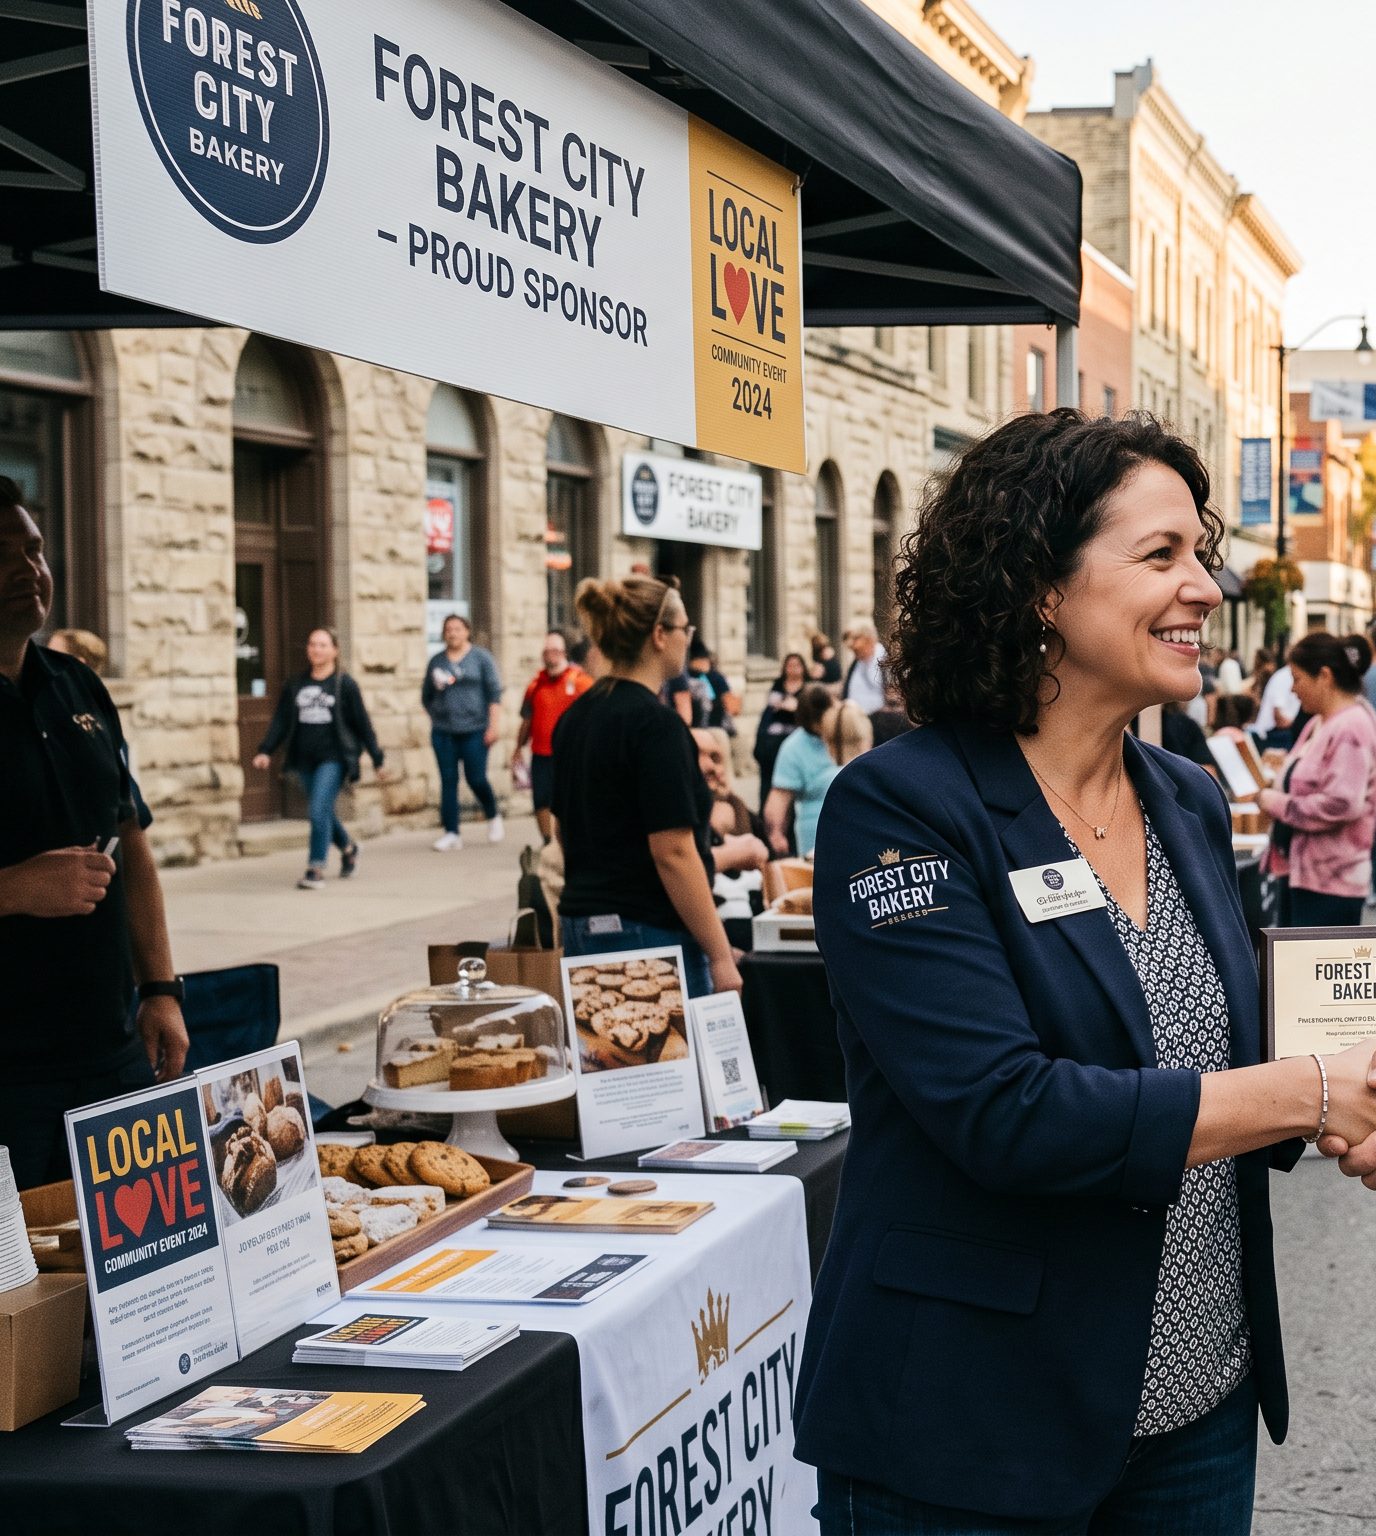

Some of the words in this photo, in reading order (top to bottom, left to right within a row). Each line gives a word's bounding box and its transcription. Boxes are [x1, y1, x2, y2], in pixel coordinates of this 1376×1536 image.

[162, 0, 298, 97] FOREST
[194, 70, 275, 144] CITY
[373, 33, 550, 174] FOREST
[562, 132, 646, 218] CITY
[189, 126, 285, 186] BAKERY
[435, 143, 602, 269] BAKERY
[708, 188, 784, 275] LOCAL
[408, 222, 515, 299] PROUD
[523, 267, 649, 347] SPONSOR
[711, 343, 762, 375] COMMUNITY
[731, 376, 772, 420] 2024
[668, 472, 722, 503] FOREST
[727, 484, 754, 508] CITY
[687, 506, 739, 535] BAKERY
[848, 866, 905, 903] FOREST
[909, 859, 949, 883] CITY
[867, 884, 934, 920] BAKERY
[1315, 961, 1372, 981] FOREST
[86, 1108, 198, 1185] LOCAL
[104, 1241, 158, 1274] COMMUNITY
[159, 1230, 187, 1253] EVENT
[188, 1222, 209, 1242] 2024
[742, 1331, 796, 1462] CITY
